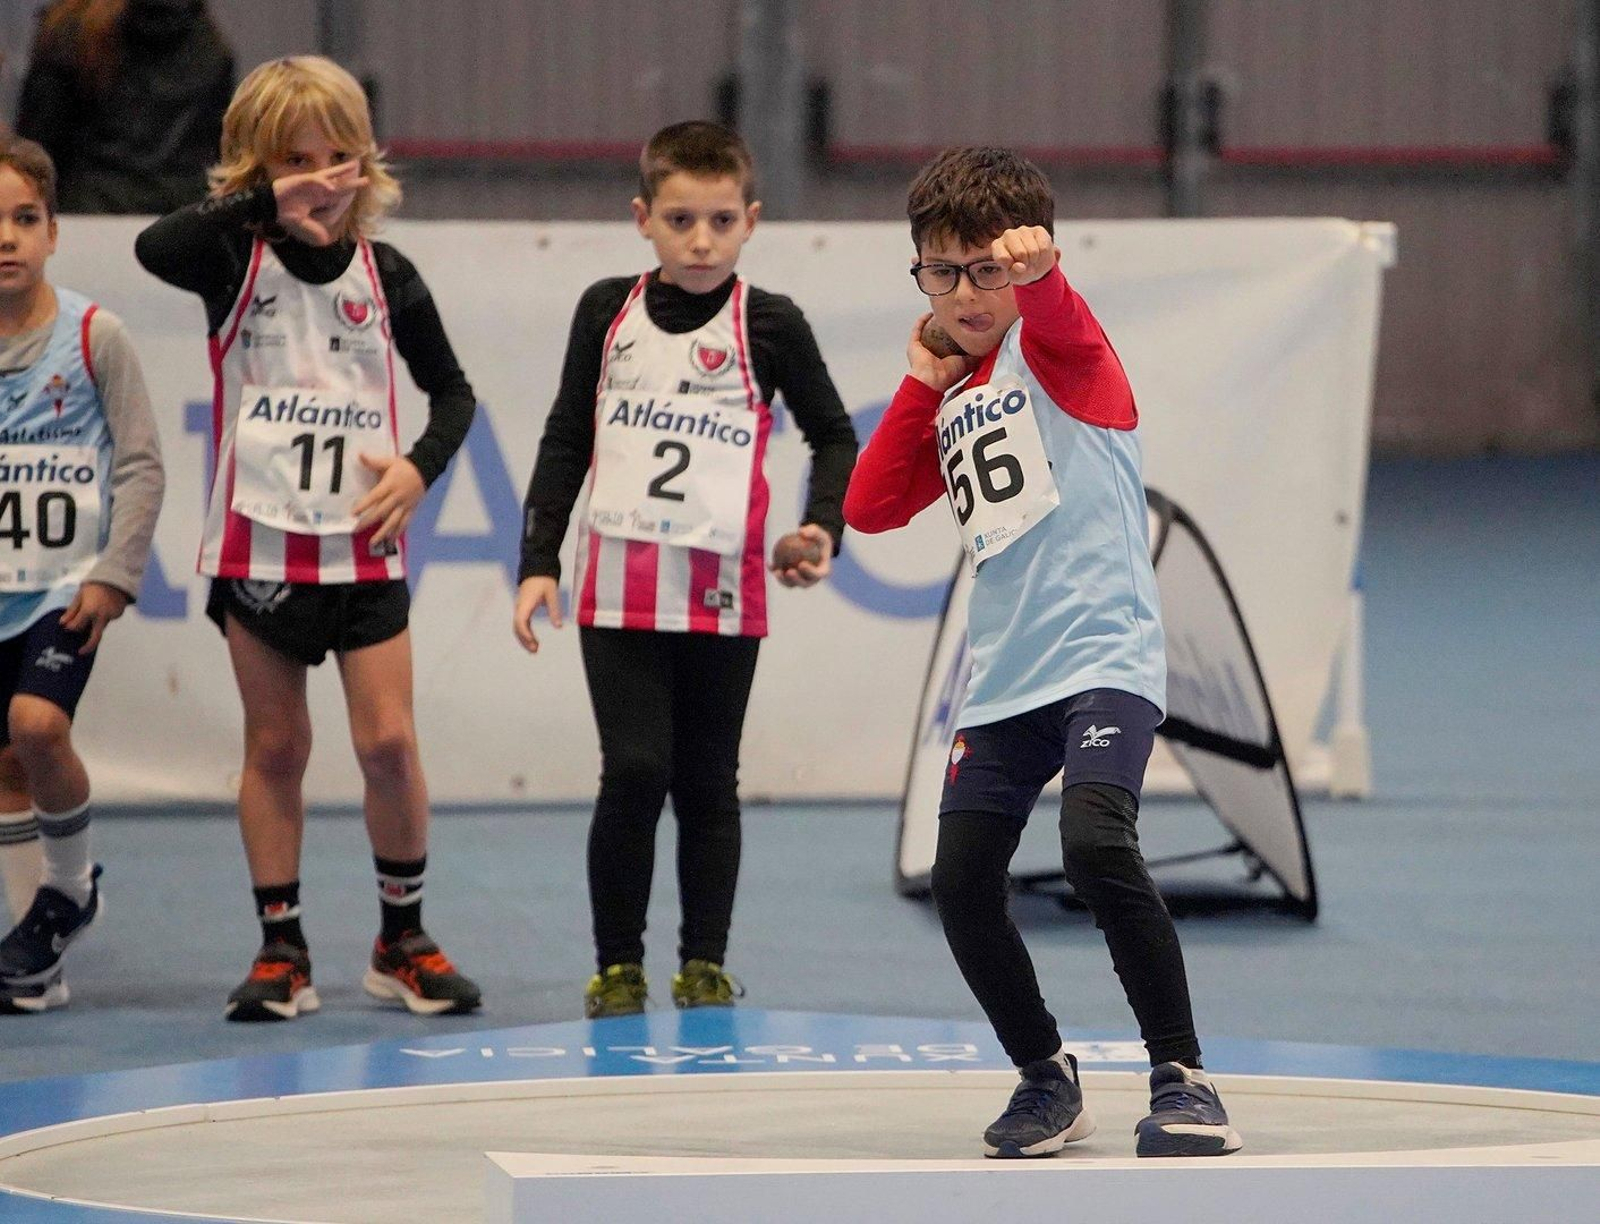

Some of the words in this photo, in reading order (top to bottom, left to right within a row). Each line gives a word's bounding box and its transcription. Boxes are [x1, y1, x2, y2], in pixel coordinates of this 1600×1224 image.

[247, 394, 382, 429] Atlántico
[607, 399, 751, 447] Atlántico
[291, 432, 345, 494] 11
[647, 440, 691, 502] 2
